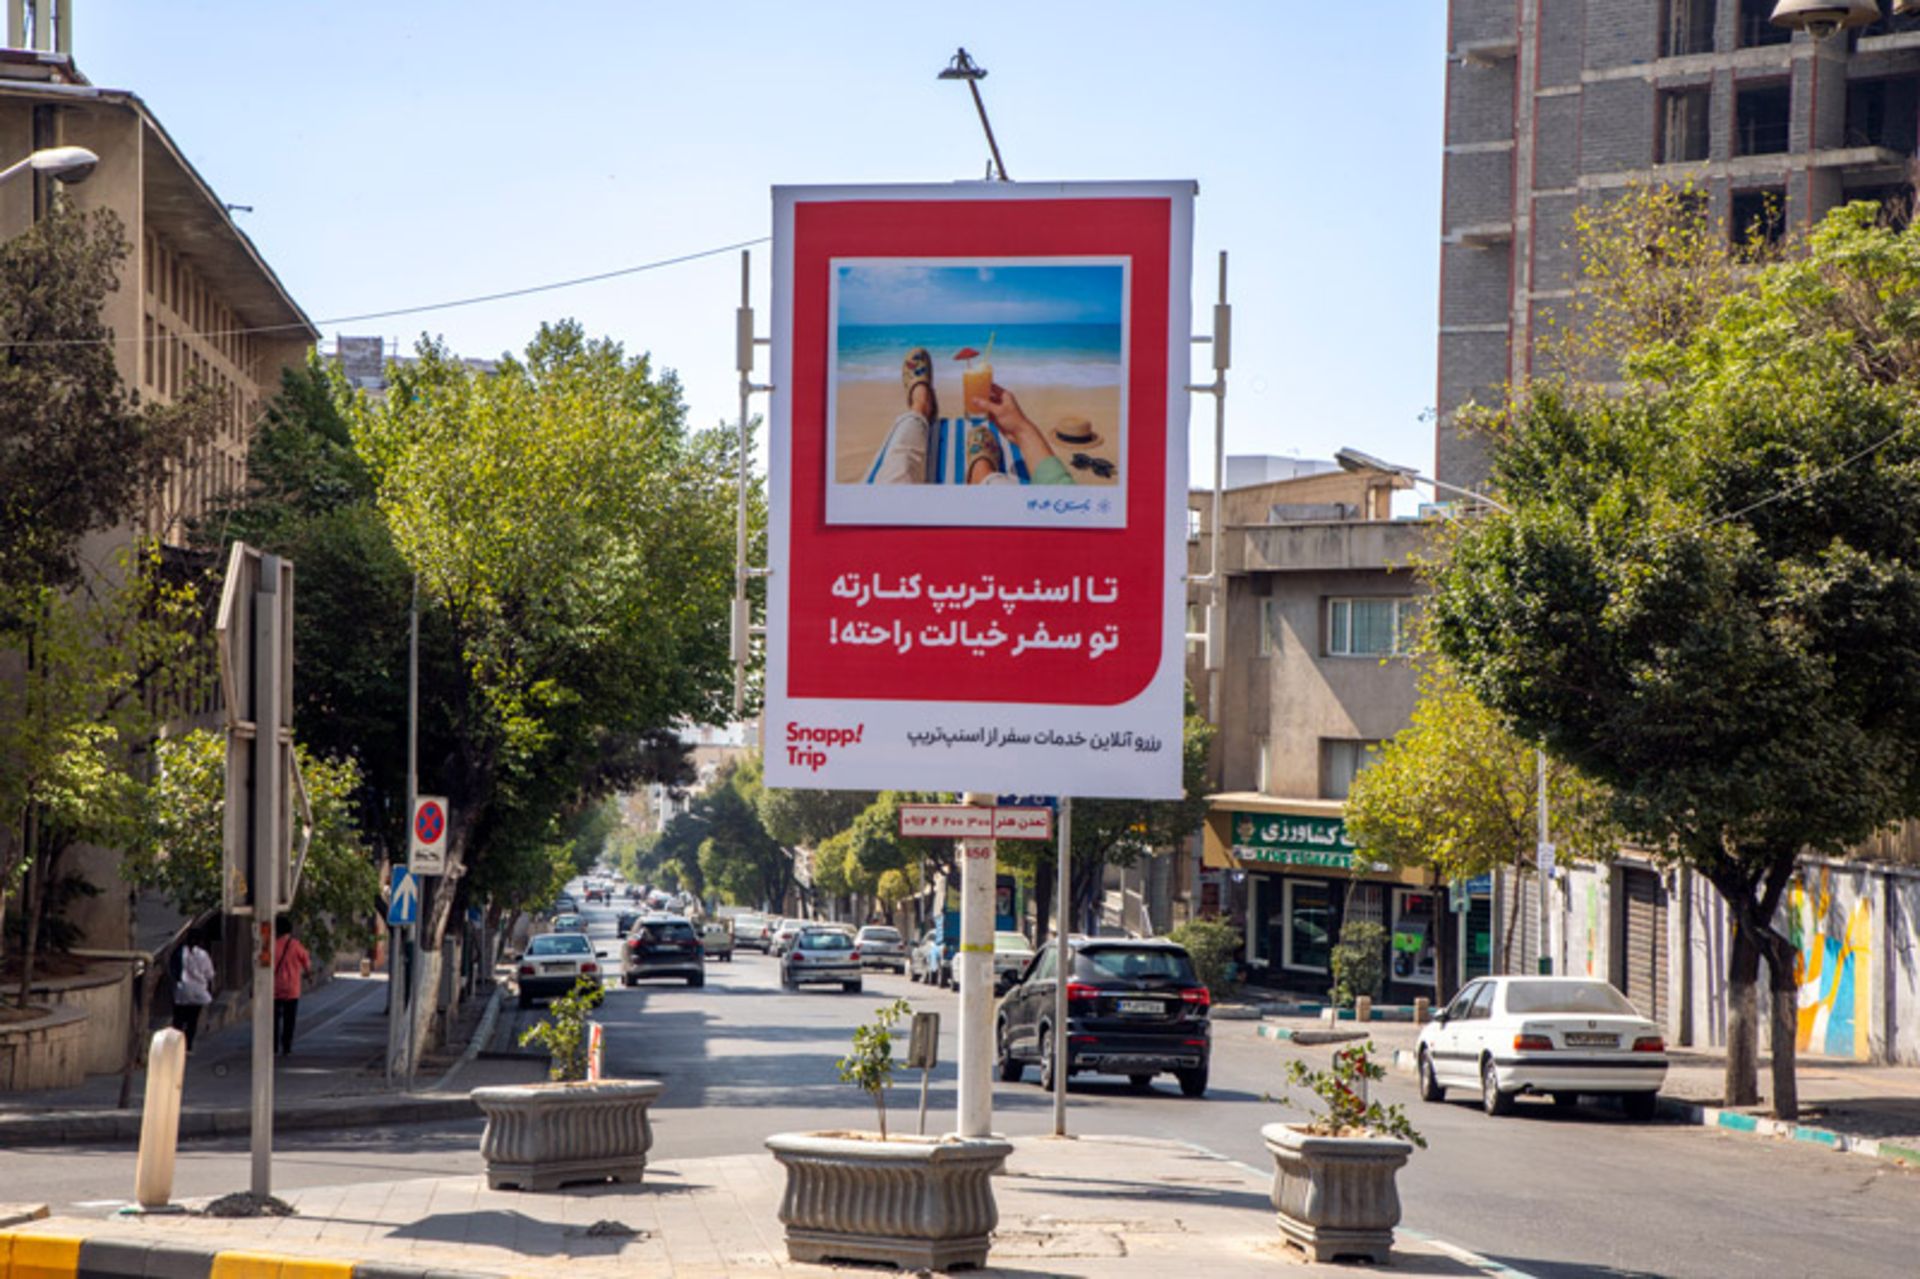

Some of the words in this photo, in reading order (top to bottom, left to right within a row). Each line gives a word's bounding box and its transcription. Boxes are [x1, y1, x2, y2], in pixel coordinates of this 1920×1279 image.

[831, 572, 922, 607] کنارته
[1086, 575, 1118, 603] تا
[829, 617, 912, 654] راحته!
[919, 620, 1008, 656] خیالت
[1011, 621, 1082, 657] سفر
[1088, 624, 1119, 659] تو
[786, 721, 864, 747] Snapp!
[984, 727, 998, 747] از
[999, 727, 1031, 747] سفر
[1033, 728, 1086, 747] خدمات
[1089, 730, 1132, 751] آنلاین
[786, 745, 827, 772] Trip
[1261, 820, 1339, 845] کشاورزی
